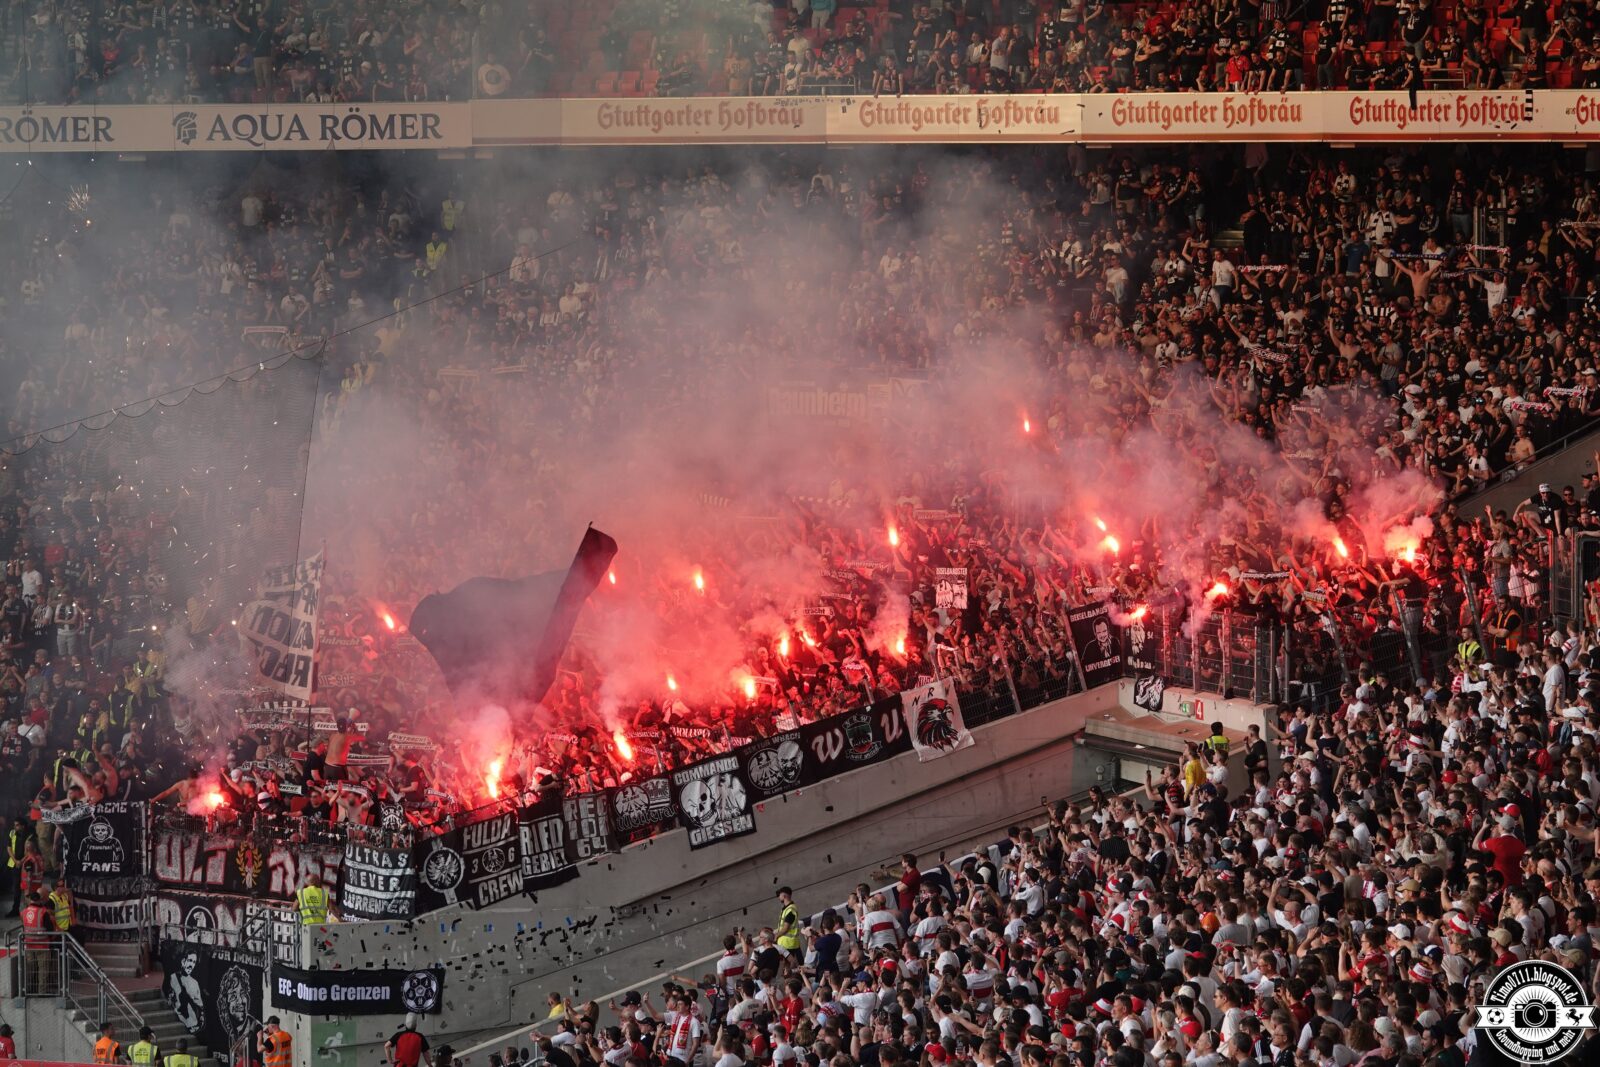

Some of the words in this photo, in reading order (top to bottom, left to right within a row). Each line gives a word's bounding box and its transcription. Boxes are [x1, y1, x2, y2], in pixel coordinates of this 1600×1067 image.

[206, 112, 310, 147] AQUA
[319, 106, 443, 141] RÖMER
[597, 101, 711, 133] Stuttgarter
[717, 101, 804, 131] Hofbräu
[859, 100, 970, 132] Stuttgarter
[976, 98, 1060, 130] Hofbräu
[1111, 97, 1217, 129] Stuttgarter
[1222, 95, 1302, 127] Hofbräu
[1349, 96, 1451, 129] Stuttgarter
[928, 687, 935, 698] R
[1196, 703, 1204, 720] 4
[463, 813, 511, 850] FULDA
[519, 817, 564, 856] RIED
[690, 814, 753, 846] GIESSEN
[345, 843, 408, 868] ULTRAS
[471, 858, 479, 874] 3
[508, 846, 515, 863] 6
[576, 835, 608, 858] 64
[82, 862, 120, 872] FANS
[521, 848, 569, 876] GEBIET
[349, 868, 400, 891] NEVER
[478, 869, 524, 906] CREW
[279, 977, 292, 996] EFC
[297, 982, 327, 1001] Ohne
[331, 984, 390, 1001] Grenzen
